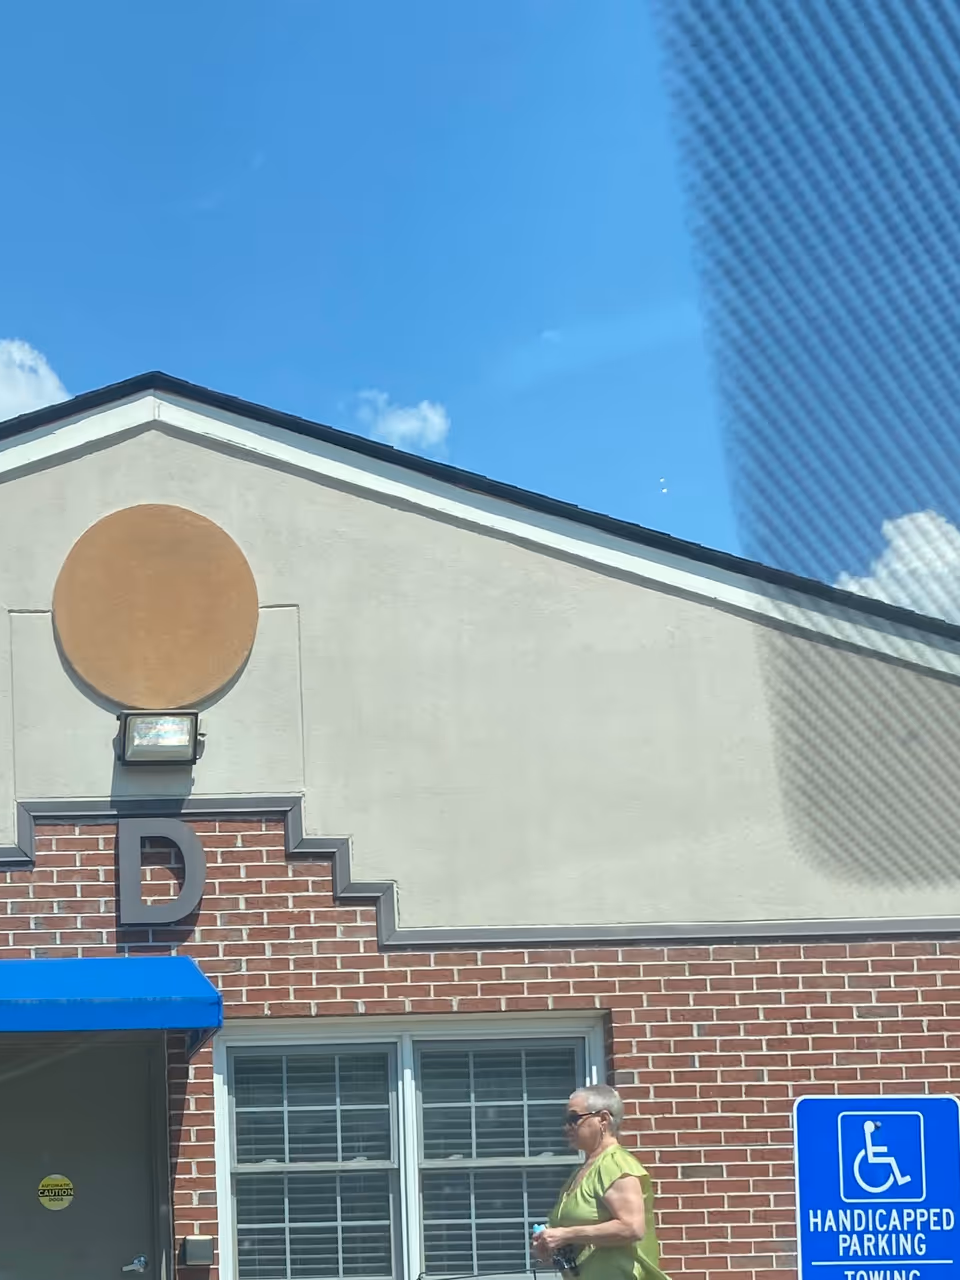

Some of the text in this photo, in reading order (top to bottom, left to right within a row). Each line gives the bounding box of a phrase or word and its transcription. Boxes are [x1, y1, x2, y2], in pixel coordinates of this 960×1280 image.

[118, 817, 207, 924] D
[808, 1208, 955, 1232] HANDICAPPED
[838, 1233, 927, 1256] PARKING
